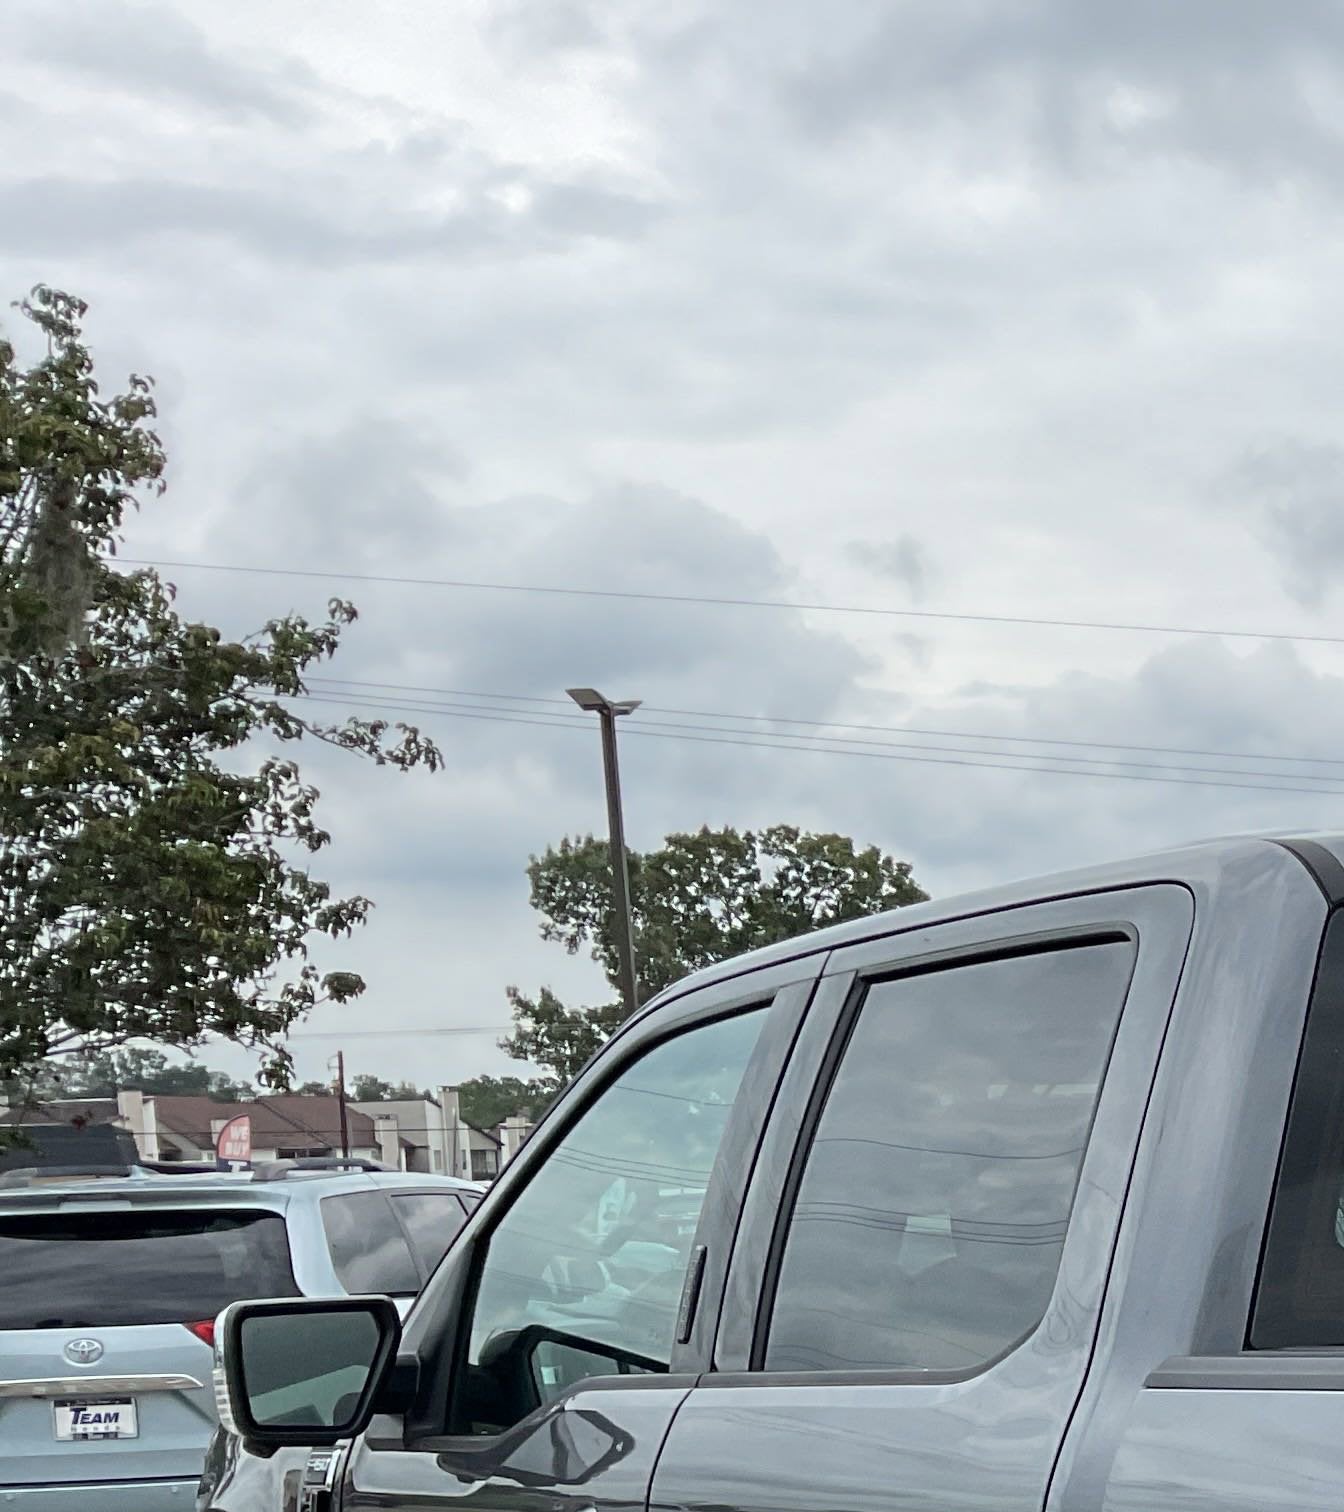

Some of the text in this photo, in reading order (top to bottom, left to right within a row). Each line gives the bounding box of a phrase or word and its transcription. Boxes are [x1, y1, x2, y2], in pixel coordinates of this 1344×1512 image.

[230, 1125, 249, 1140] WE
[225, 1141, 250, 1156] BUY
[70, 1407, 120, 1424] TEAM
